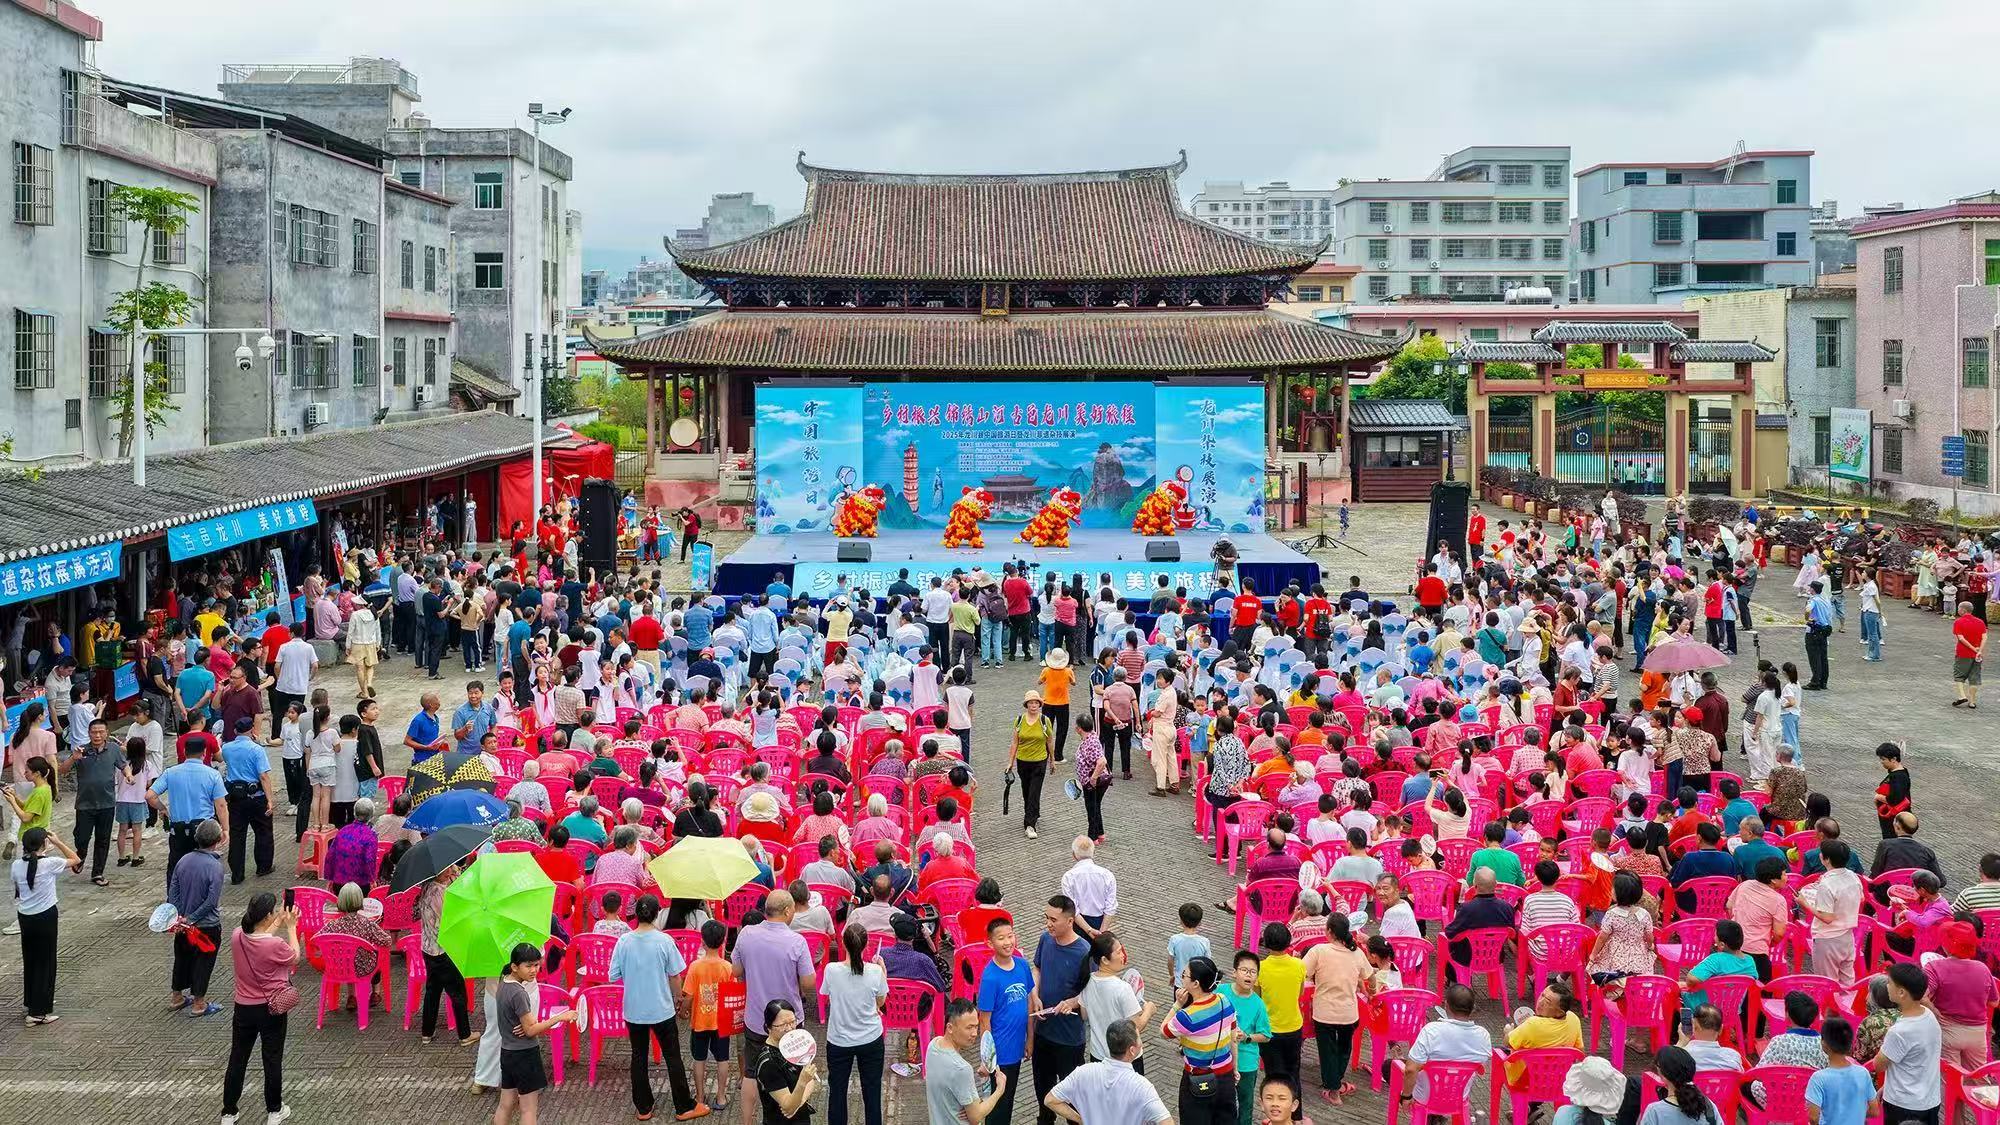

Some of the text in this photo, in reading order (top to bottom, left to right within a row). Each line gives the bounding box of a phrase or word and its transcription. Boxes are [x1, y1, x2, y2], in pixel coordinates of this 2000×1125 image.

[882, 404, 941, 426] 乡村振兴
[1011, 403, 1069, 426] 古邑龙川
[1074, 402, 1136, 427] 美好旅程
[803, 400, 820, 505] 中国旅游日
[1200, 400, 1217, 504] 龙川杂技展演
[178, 503, 310, 553] 古邑龙川 美好旅程
[2, 549, 114, 597] 遗杂技展演活动
